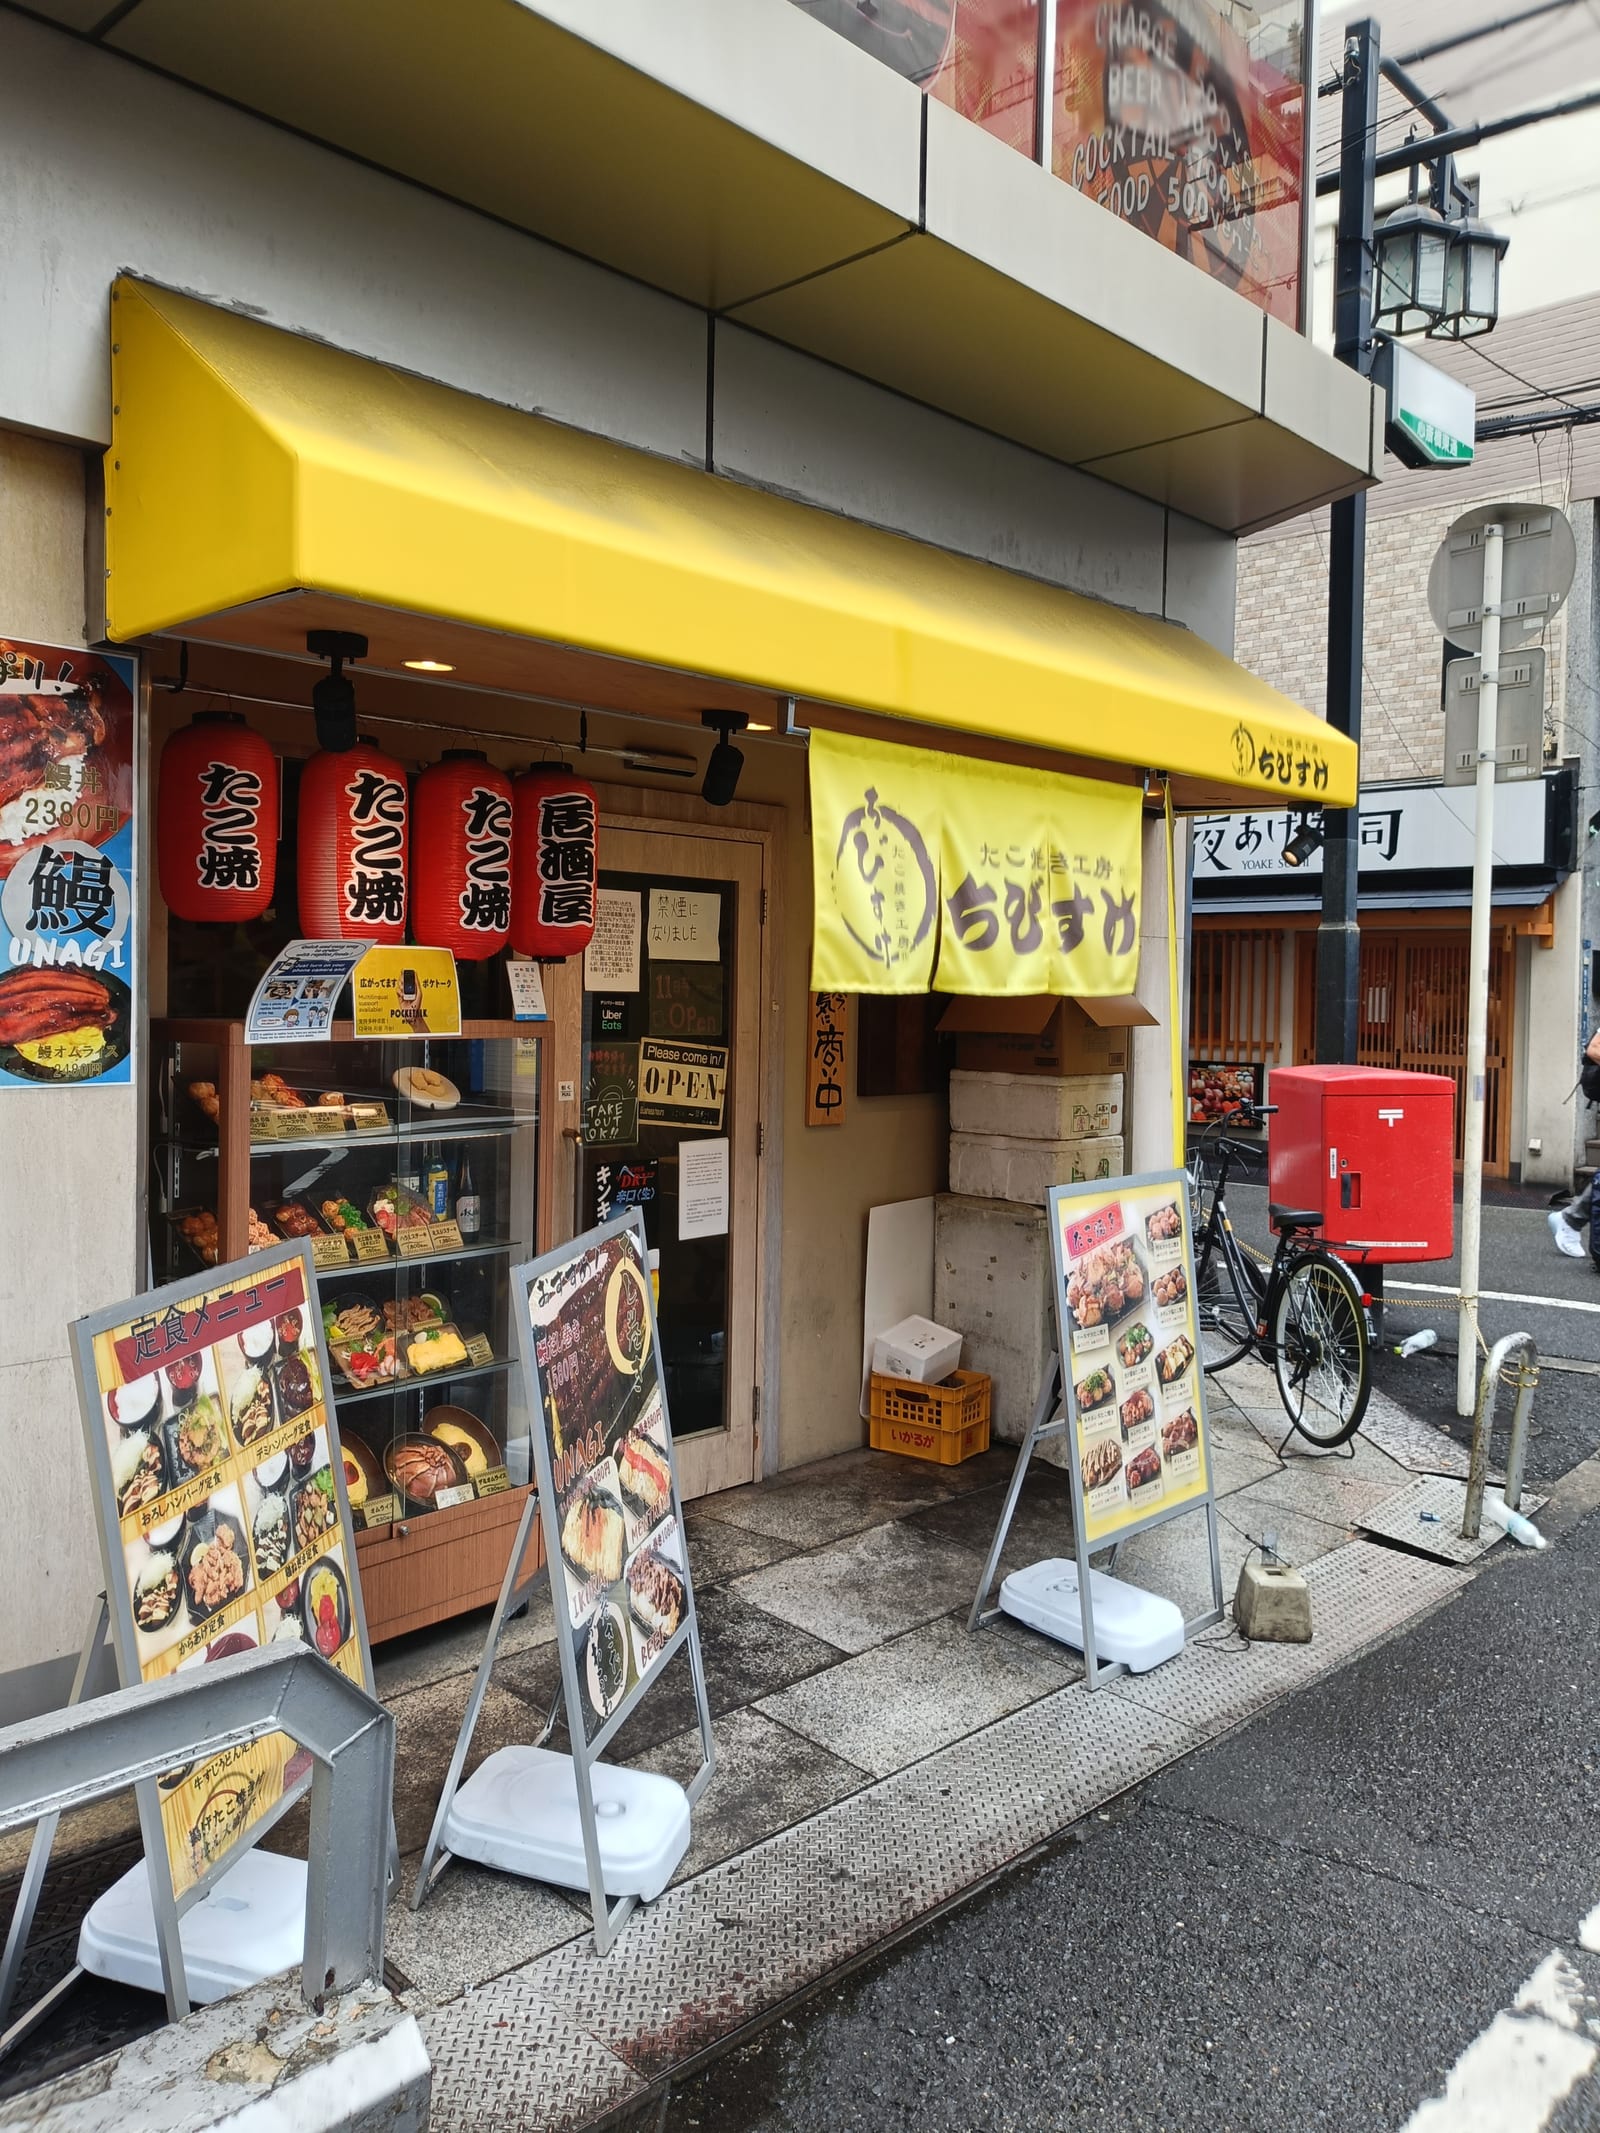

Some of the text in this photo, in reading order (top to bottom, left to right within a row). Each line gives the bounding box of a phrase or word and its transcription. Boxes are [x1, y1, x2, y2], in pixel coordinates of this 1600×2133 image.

[1072, 125, 1175, 190] COCKTAIL
[44, 760, 102, 793] 鰻丼
[25, 798, 119, 832] 2380円
[197, 761, 262, 891] たこ焼
[344, 769, 405, 926] たこ焼
[1193, 809, 1404, 871] 夜あけ司
[461, 784, 512, 932] たこ焼
[537, 792, 597, 927] 居酒屋
[1241, 859, 1274, 870] YOAKE
[27, 844, 114, 939] 鰻
[657, 896, 699, 919] 禁煙に
[946, 872, 1136, 957] ちびすけ
[651, 924, 697, 943] なりました
[8, 936, 126, 970] UNAGI
[360, 978, 452, 988] 広がってます ポケトーク
[390, 1009, 428, 1018] POCKETALK
[602, 1010, 622, 1020] Uber
[602, 1020, 622, 1030] Eats
[38, 1044, 119, 1059] 鰻オムライス
[647, 1045, 722, 1066] Please come in!
[587, 1102, 623, 1118] TAKE
[594, 1116, 622, 1127] OUT
[589, 1127, 620, 1139] OK!!
[130, 1278, 286, 1365] 定食メニュー
[890, 1428, 934, 1448] いかるが
[553, 1421, 605, 1494] UNAGI
[141, 1471, 223, 1528] おろしハンバーグ定食
[178, 1613, 226, 1657] からあげ定食
